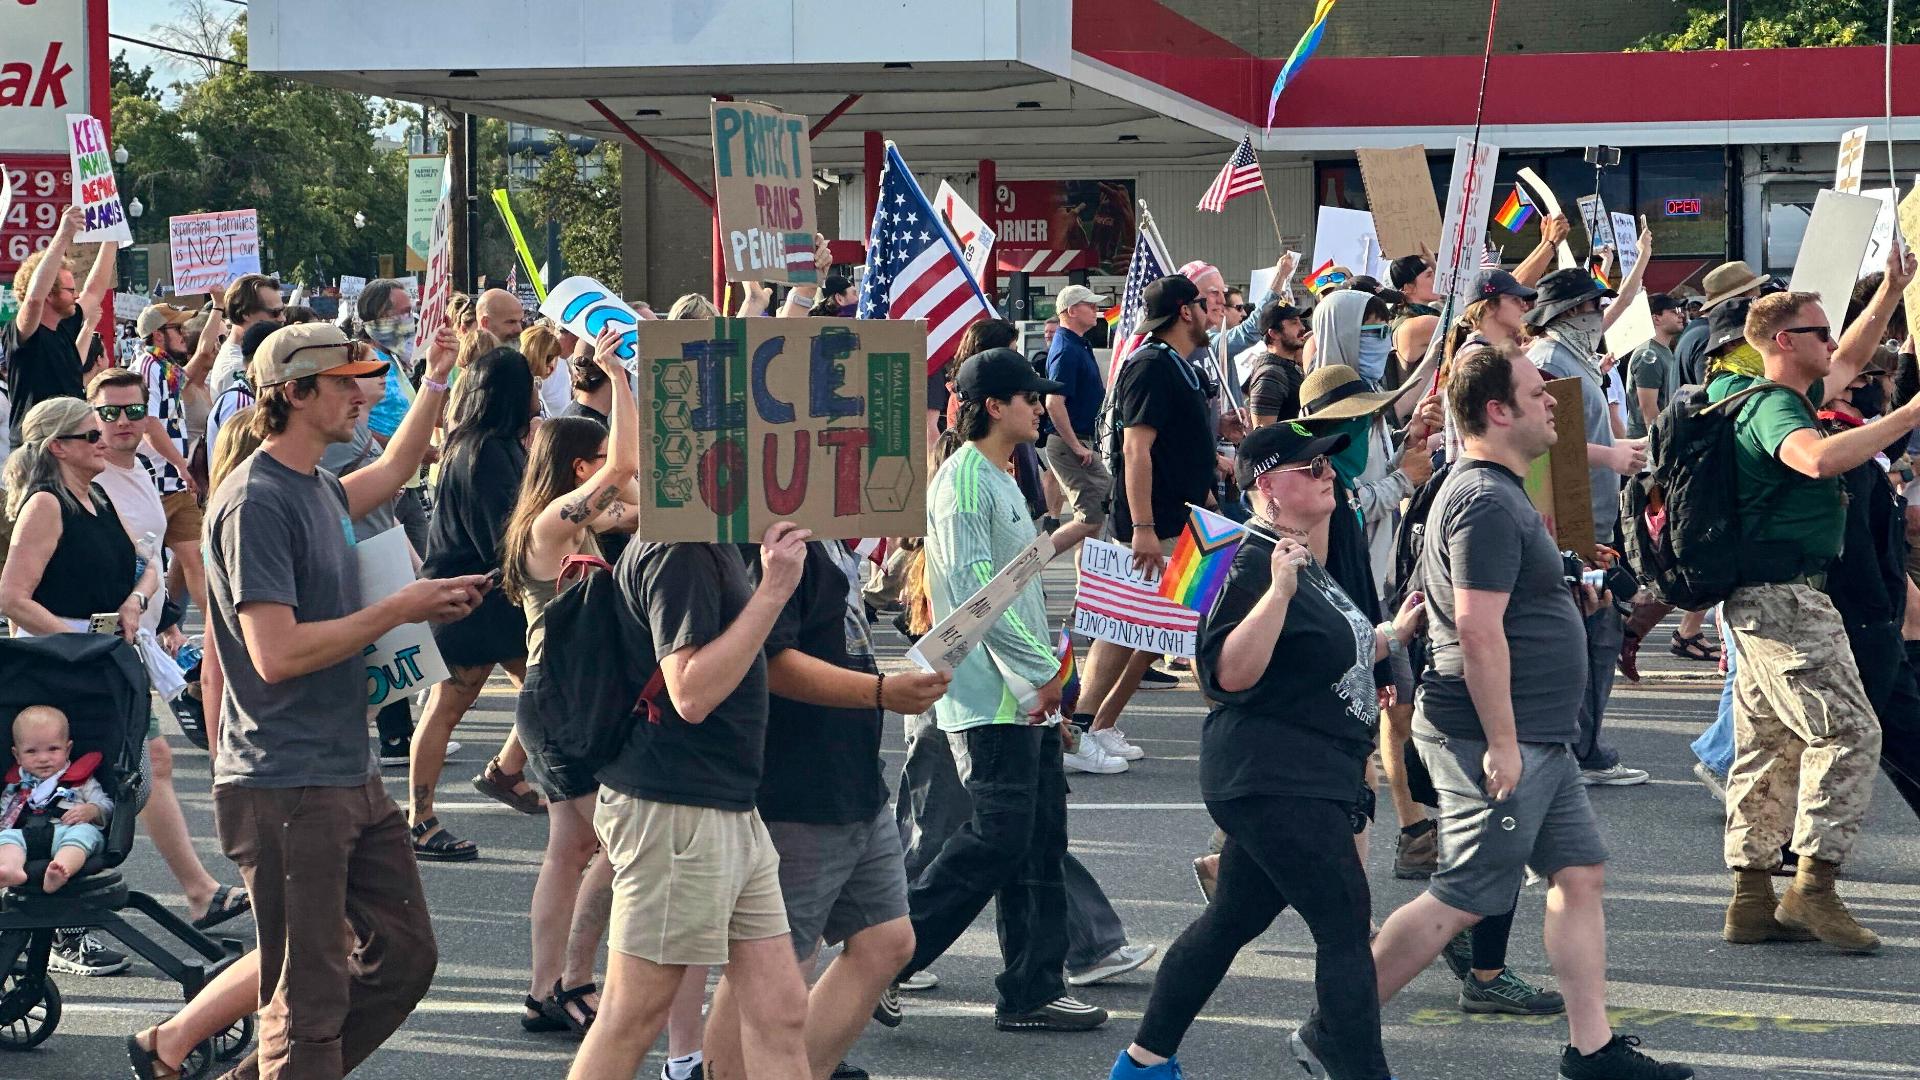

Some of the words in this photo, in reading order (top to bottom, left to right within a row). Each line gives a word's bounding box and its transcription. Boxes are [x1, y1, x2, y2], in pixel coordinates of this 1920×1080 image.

[716, 107, 803, 179] PROTECT
[1467, 142, 1490, 168] TUMP
[754, 184, 804, 230] TRANS
[1457, 196, 1478, 218] MSK
[1667, 201, 1699, 213] OPEN
[171, 217, 210, 243] separating
[216, 213, 255, 233] families
[996, 219, 1048, 242] ORNER
[176, 250, 183, 262] is
[188, 234, 237, 267] NOT
[240, 242, 255, 256] our
[730, 228, 786, 272] PEOPLE
[1451, 246, 1473, 271] BTH
[681, 332, 865, 432] ICE
[893, 362, 903, 399] SMALL
[697, 427, 875, 518] OUT
[1087, 544, 1120, 573] WELL
[938, 624, 963, 646] HIS
[1076, 611, 1107, 636] ONCE
[1109, 620, 1144, 647] KING
[1146, 630, 1155, 647] A
[1159, 631, 1184, 654] HAD
[1188, 634, 1198, 656] E
